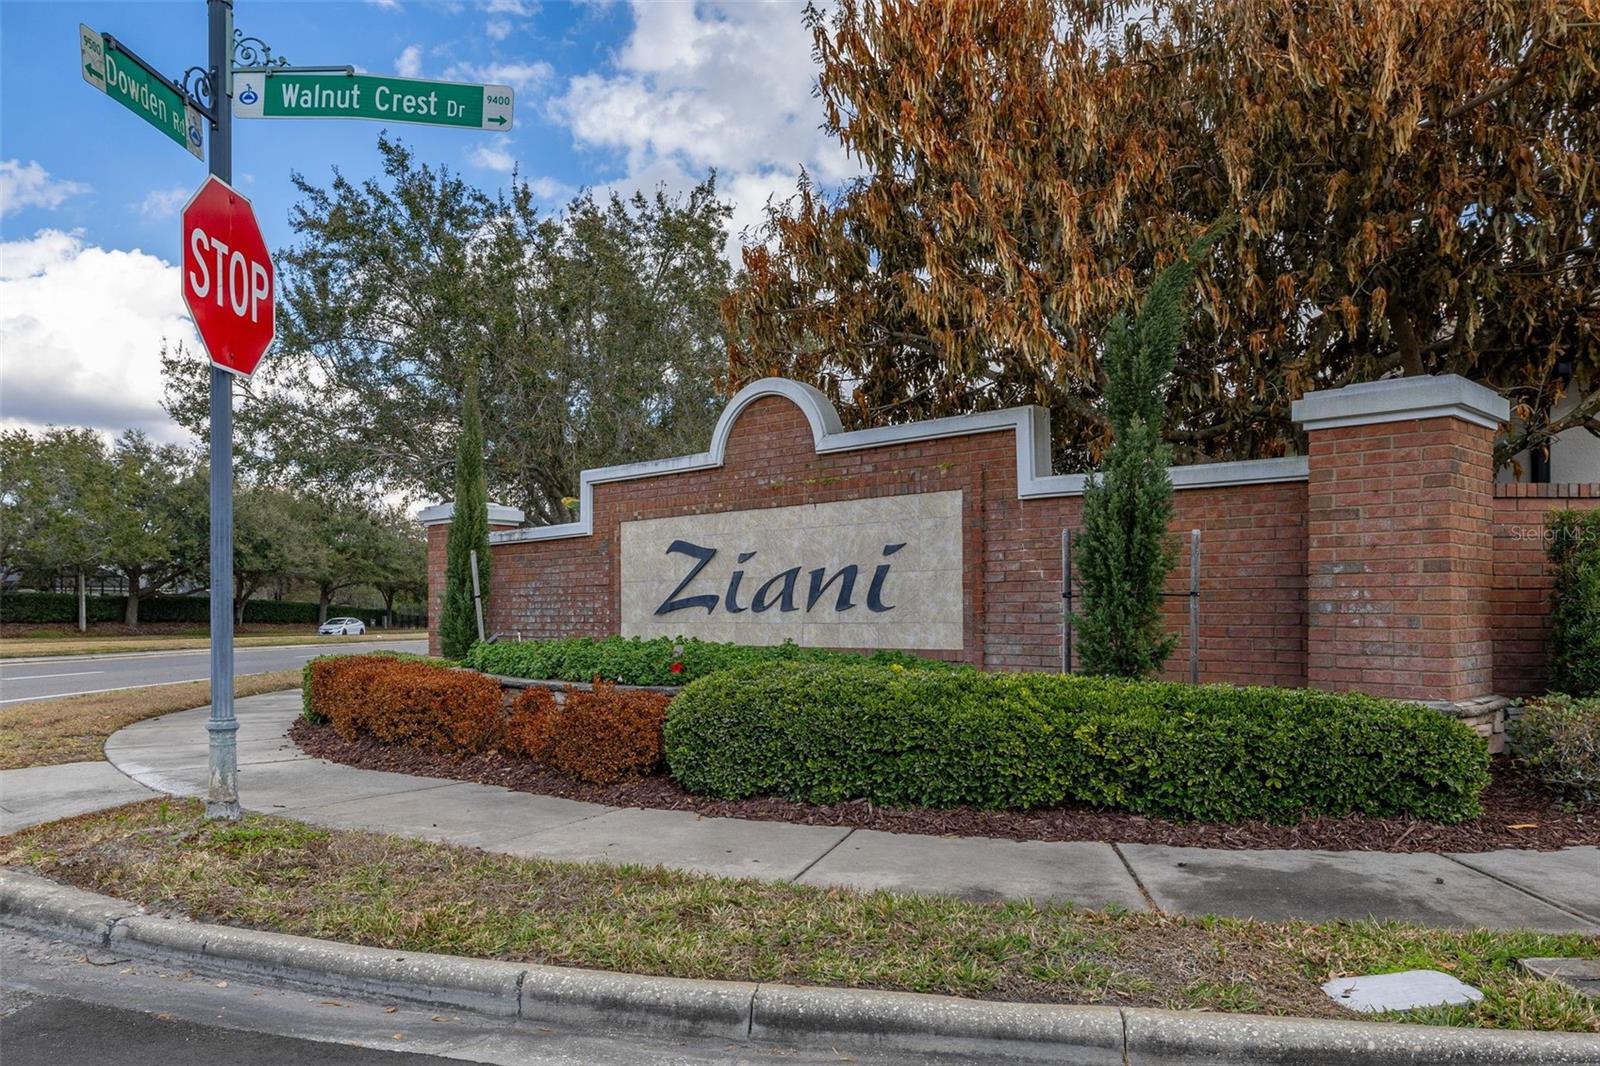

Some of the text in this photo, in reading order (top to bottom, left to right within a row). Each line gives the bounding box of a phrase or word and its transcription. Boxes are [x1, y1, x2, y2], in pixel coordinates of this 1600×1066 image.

[105, 53, 186, 137] Dowden Rd
[281, 82, 466, 118] Walnut Crest Dr
[487, 95, 511, 106] 9400
[190, 228, 269, 323] STOP
[654, 540, 907, 616] Ziani
